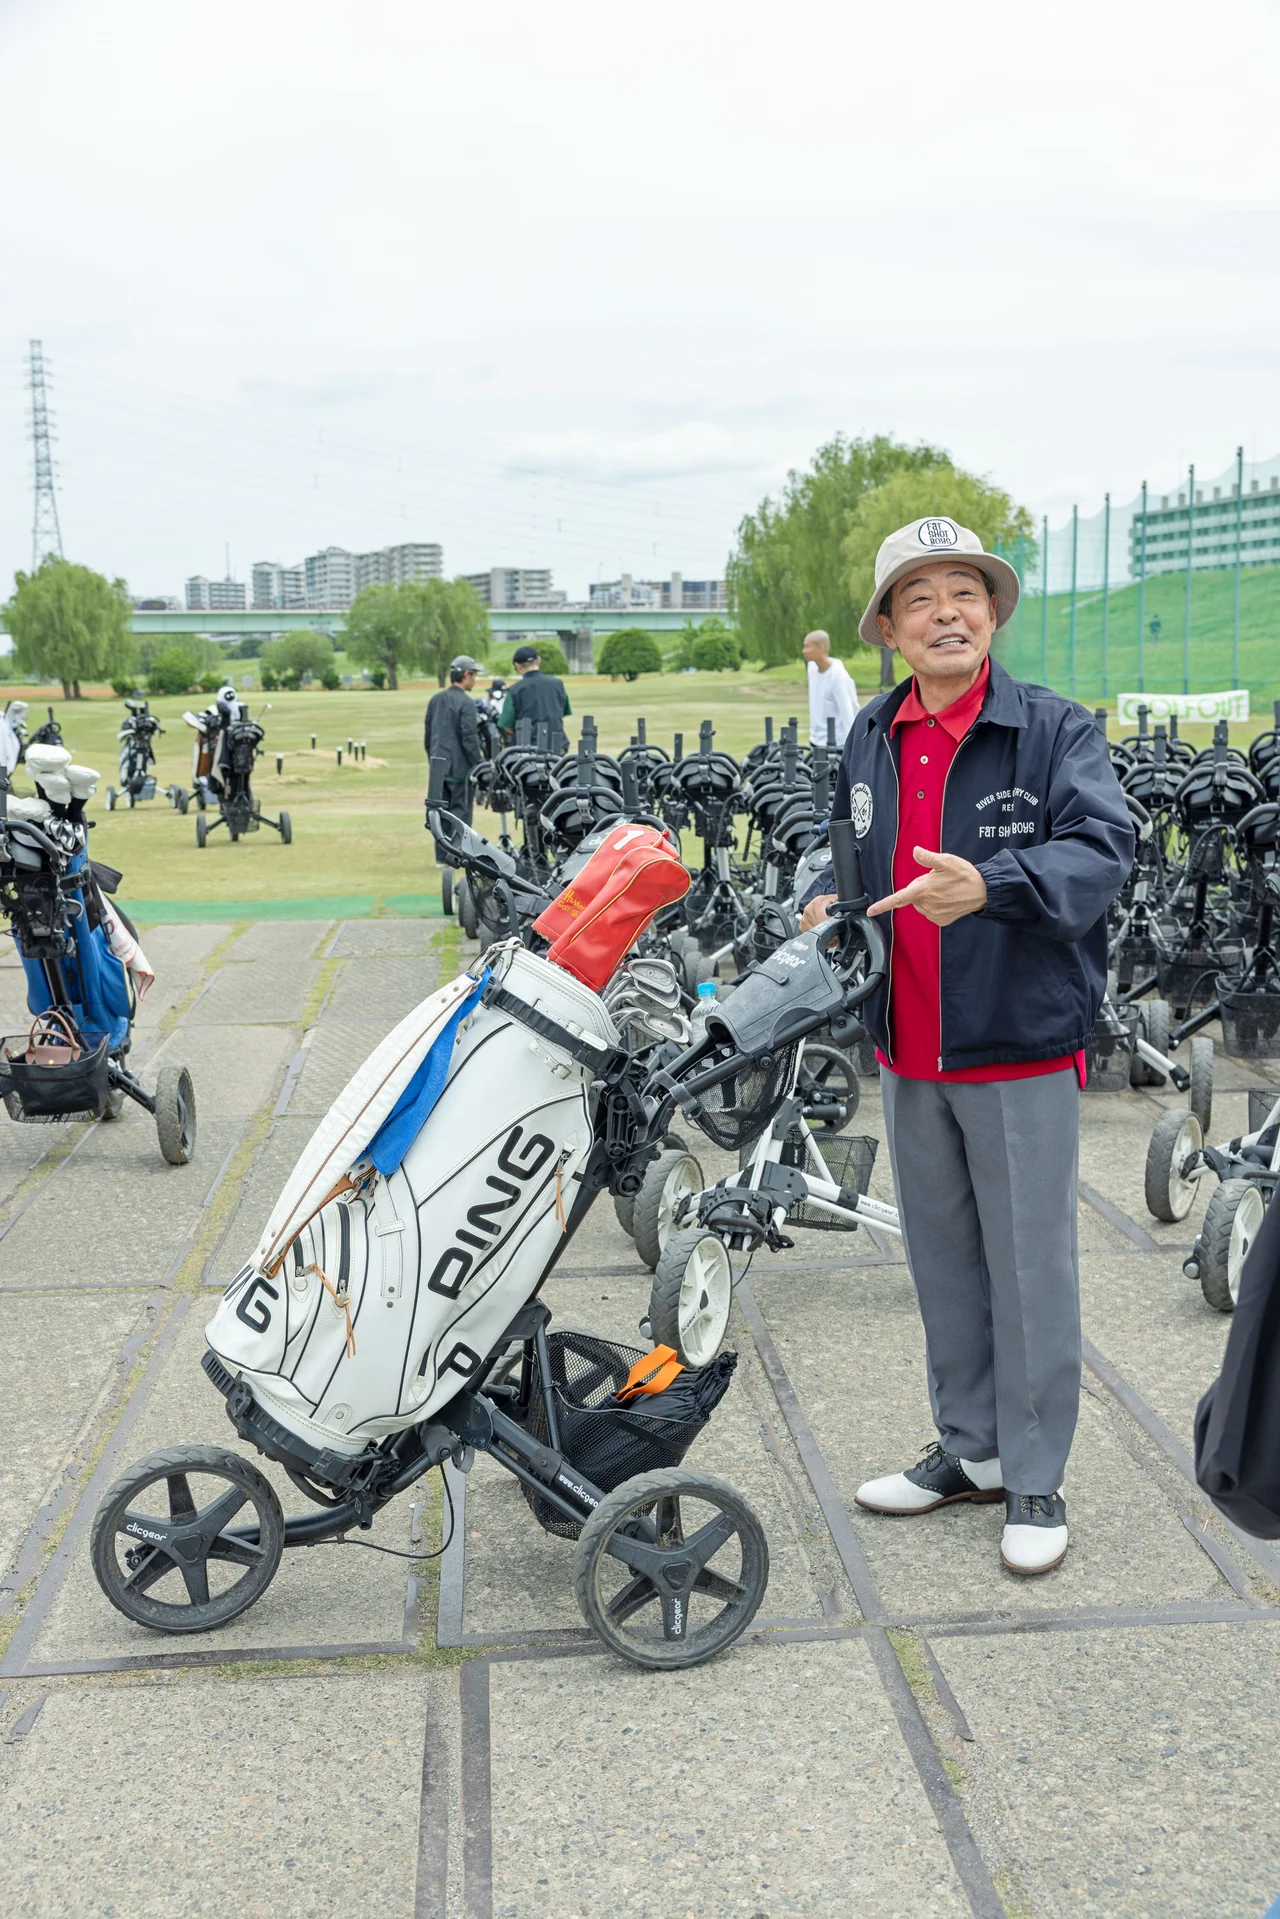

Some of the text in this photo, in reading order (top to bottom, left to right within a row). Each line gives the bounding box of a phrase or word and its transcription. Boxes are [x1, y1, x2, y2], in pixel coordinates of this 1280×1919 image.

[976, 795, 995, 810] RIVER
[996, 790, 1011, 800] SIDE
[1023, 792, 1039, 806] CLUB
[1012, 822, 1035, 834] BOYS
[613, 830, 645, 851] 1
[427, 1125, 556, 1300] PING
[437, 1342, 482, 1380] P
[126, 1522, 168, 1541] clicgear
[671, 1598, 683, 1634] clicgear
